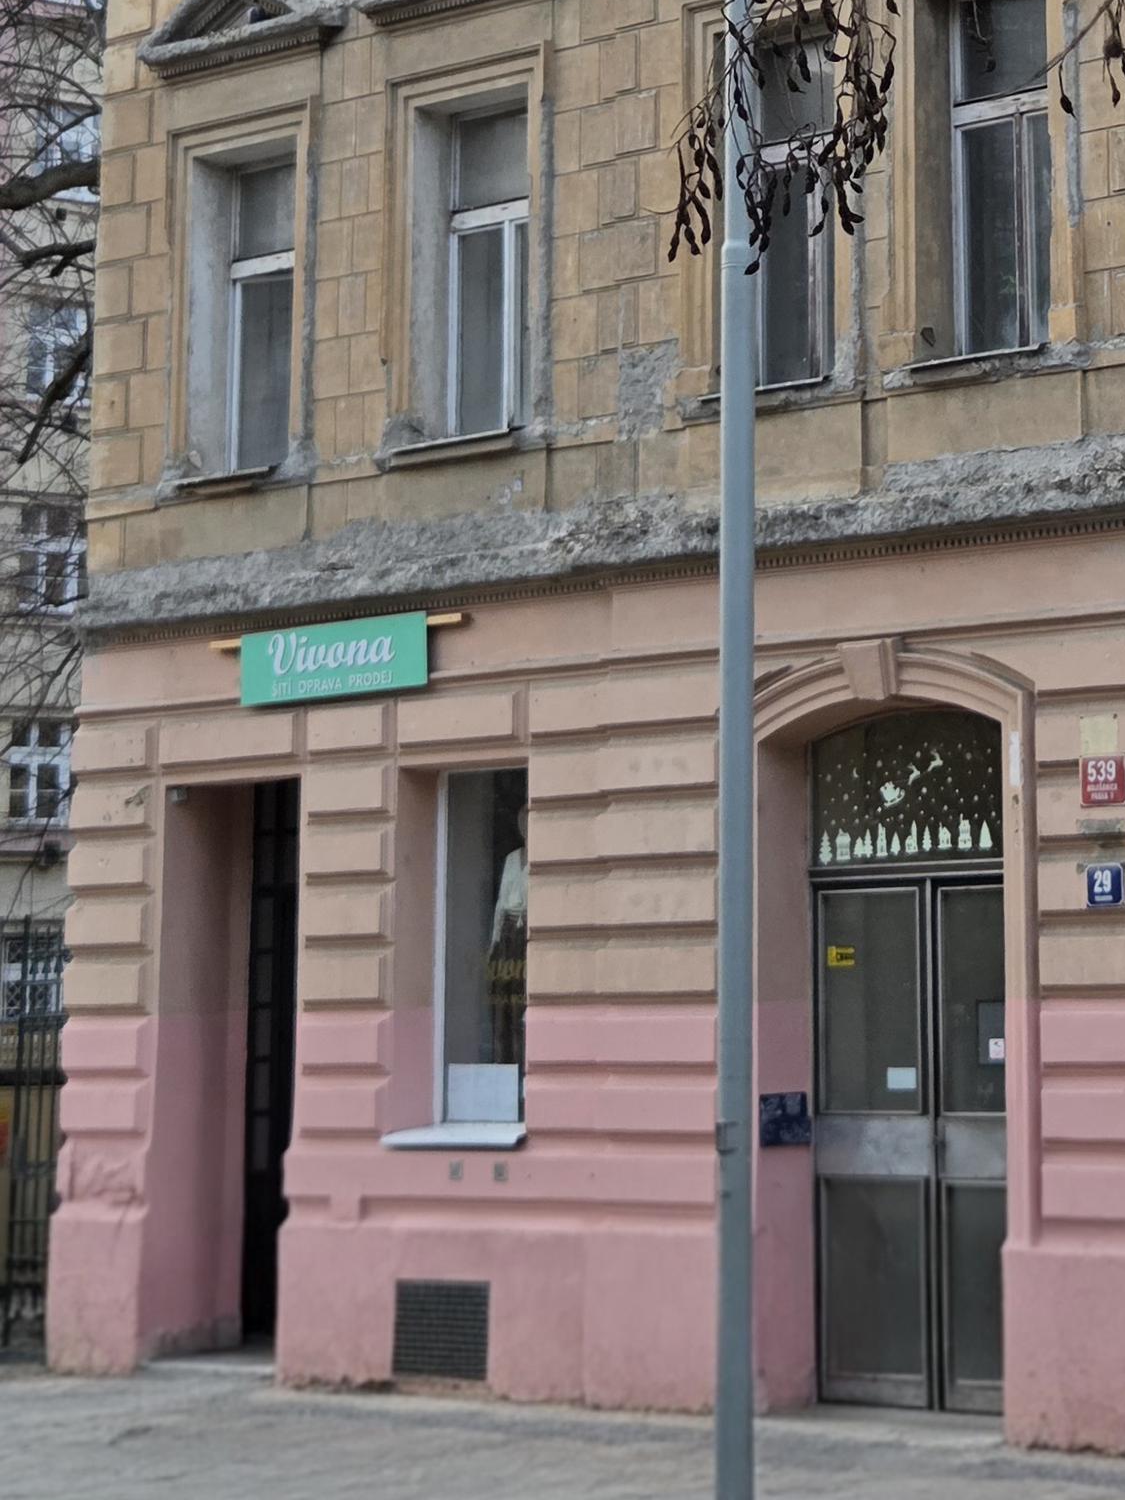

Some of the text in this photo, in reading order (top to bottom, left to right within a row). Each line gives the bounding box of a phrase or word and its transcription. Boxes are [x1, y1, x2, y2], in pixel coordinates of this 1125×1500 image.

[268, 632, 396, 676] Vivona
[299, 678, 342, 693] OPRAVA
[348, 671, 392, 687] PRODEJ
[1087, 760, 1116, 782] 539
[1094, 869, 1112, 893] 29
